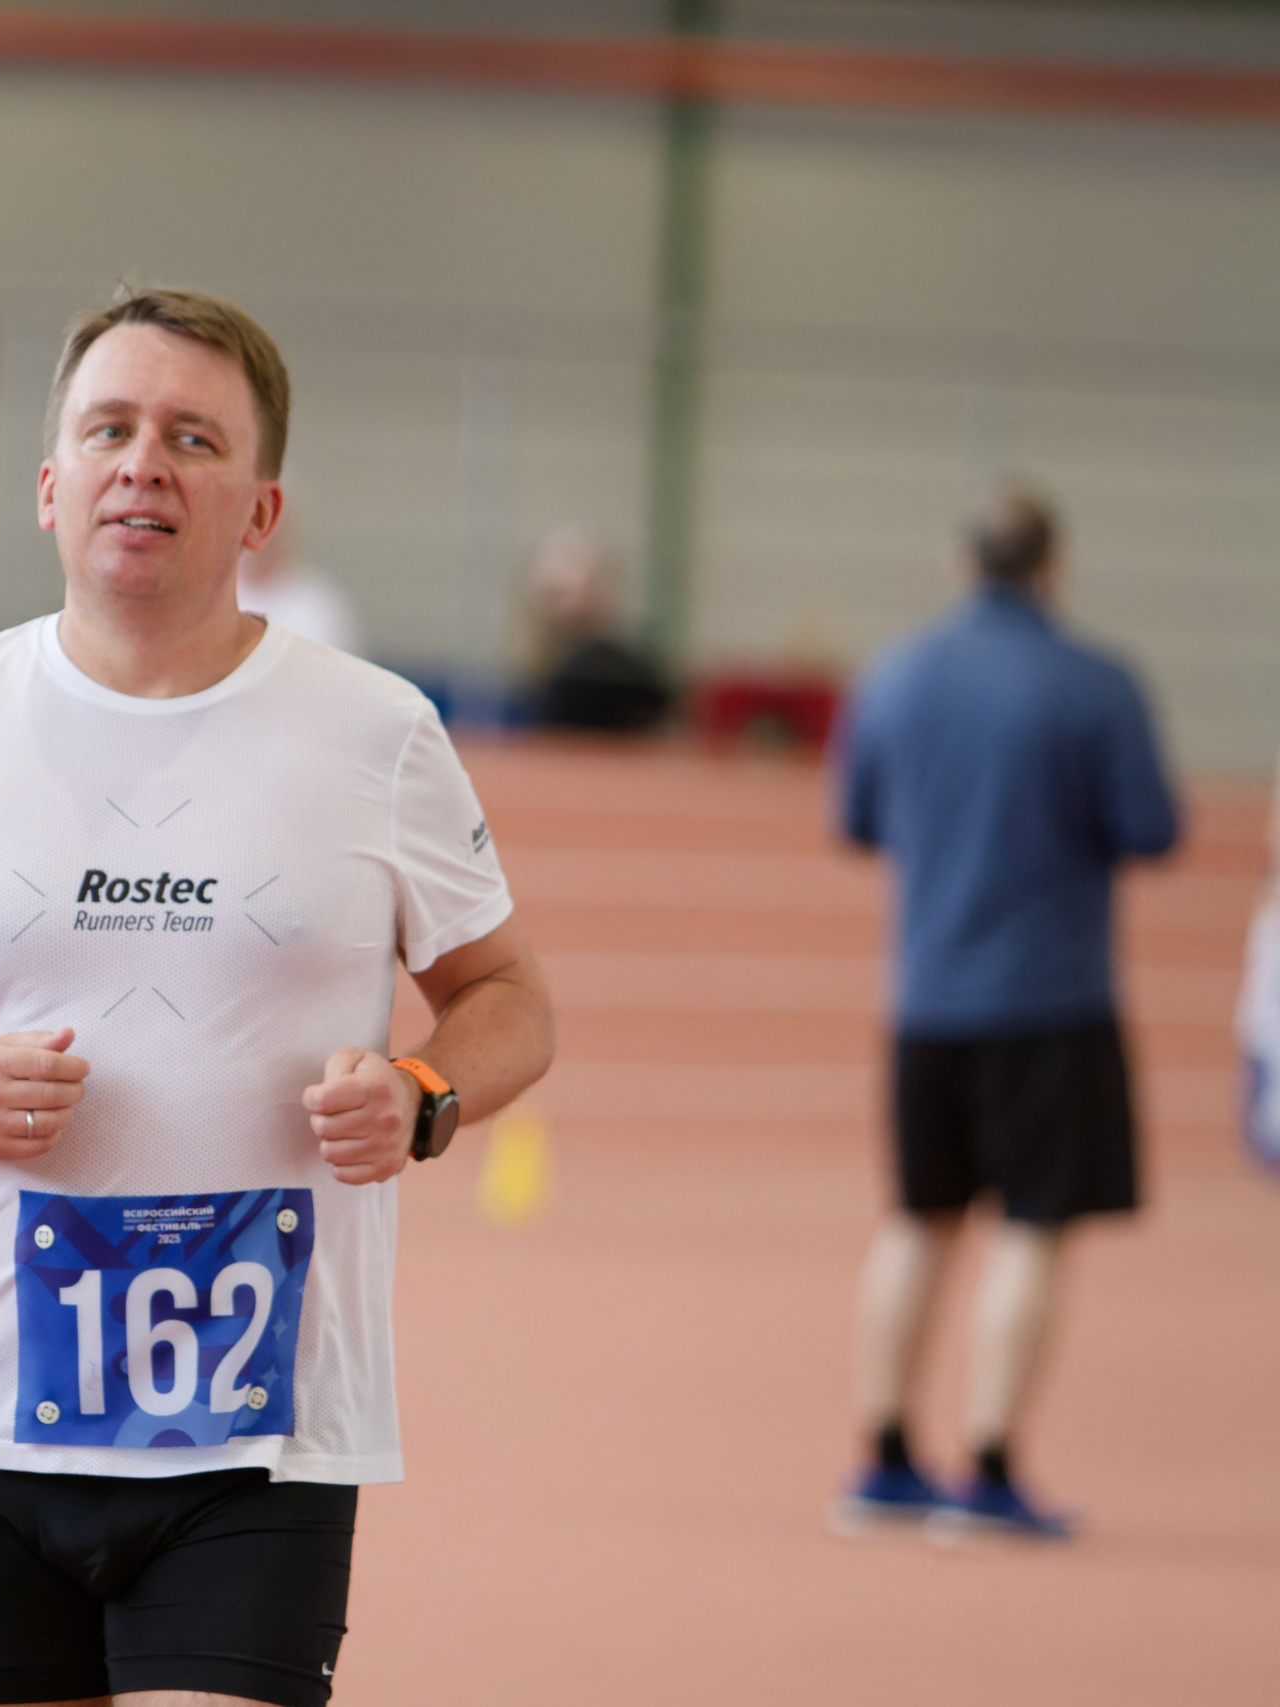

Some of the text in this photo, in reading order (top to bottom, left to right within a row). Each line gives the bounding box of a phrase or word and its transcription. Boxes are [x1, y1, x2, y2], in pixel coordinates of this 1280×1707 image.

[77, 869, 217, 904] Rostec
[74, 910, 213, 931] Runners Team
[123, 1205, 214, 1217] ВСЕРОССИЙСКИЙ
[137, 1222, 201, 1232] ФЕСТИВАЛЬ
[158, 1233, 181, 1244] 2025
[60, 1262, 273, 1416] 162
